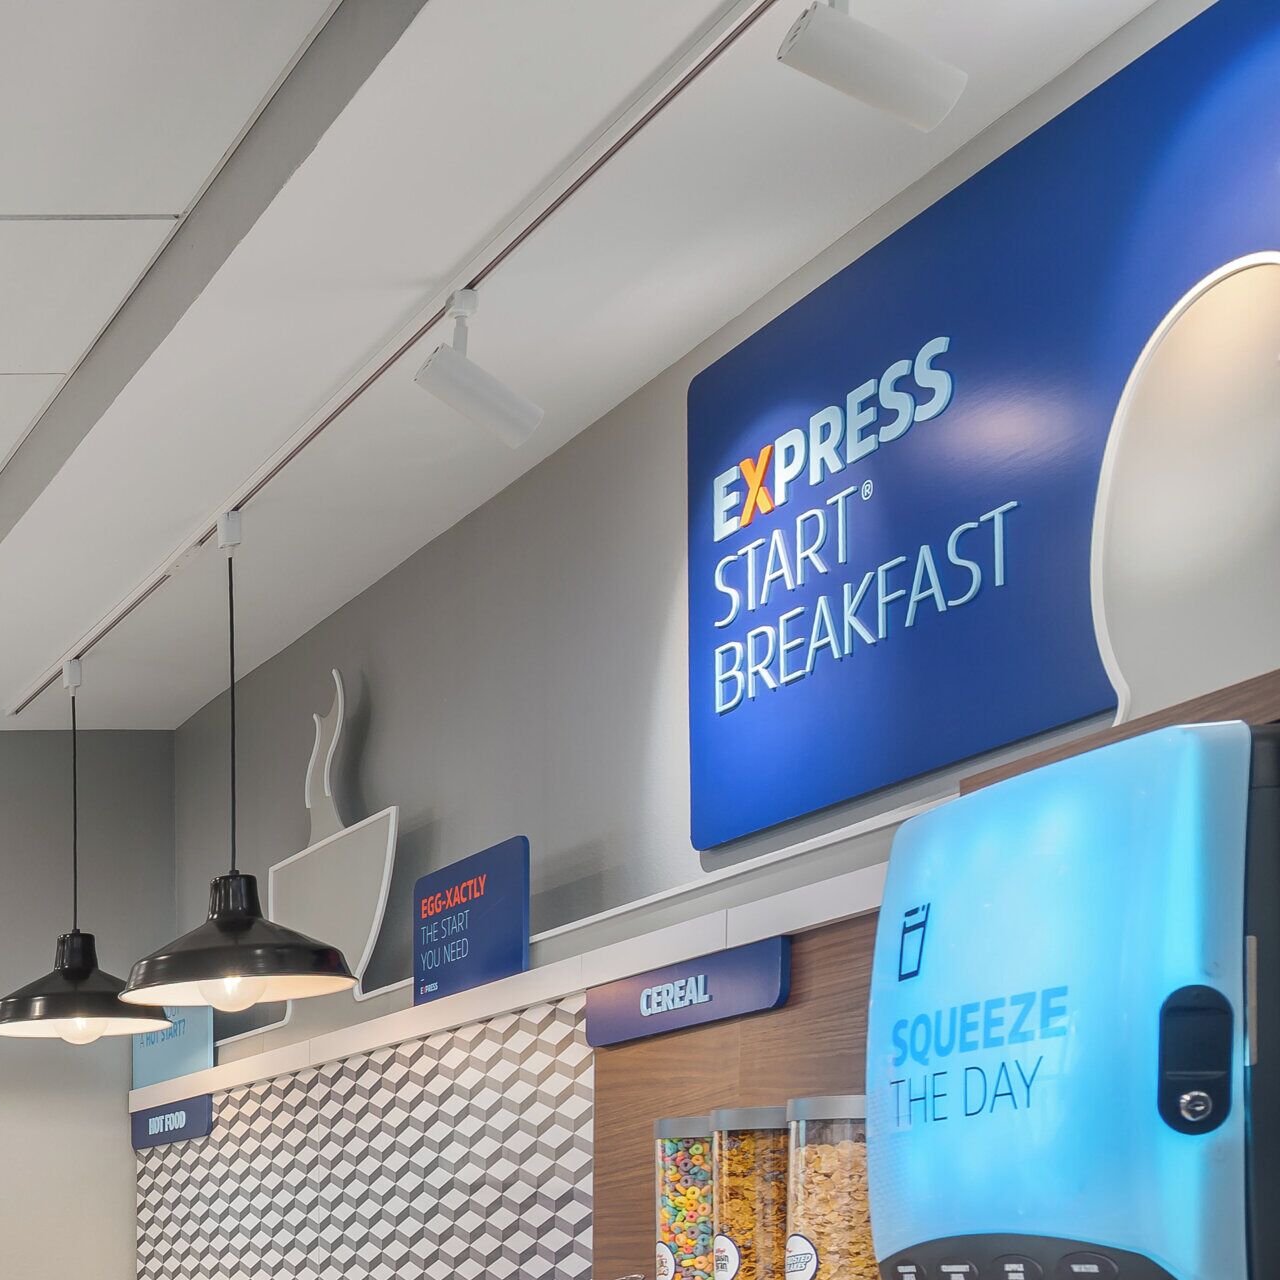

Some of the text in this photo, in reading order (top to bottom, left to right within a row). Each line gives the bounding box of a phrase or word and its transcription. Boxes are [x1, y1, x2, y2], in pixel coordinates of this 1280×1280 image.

[712, 336, 955, 543] EXPRESS
[714, 500, 1019, 715] BREAKFAST
[420, 873, 487, 920] EGG-XACTLY
[421, 910, 470, 945] THE START
[421, 938, 469, 971] YOU NEED
[420, 982, 438, 995] EXPRESS
[639, 974, 711, 1017] CEREAL
[892, 986, 1069, 1067] SQUEEZE
[890, 1056, 1044, 1127] THE DAY
[148, 1110, 186, 1135] HOT FOOD
